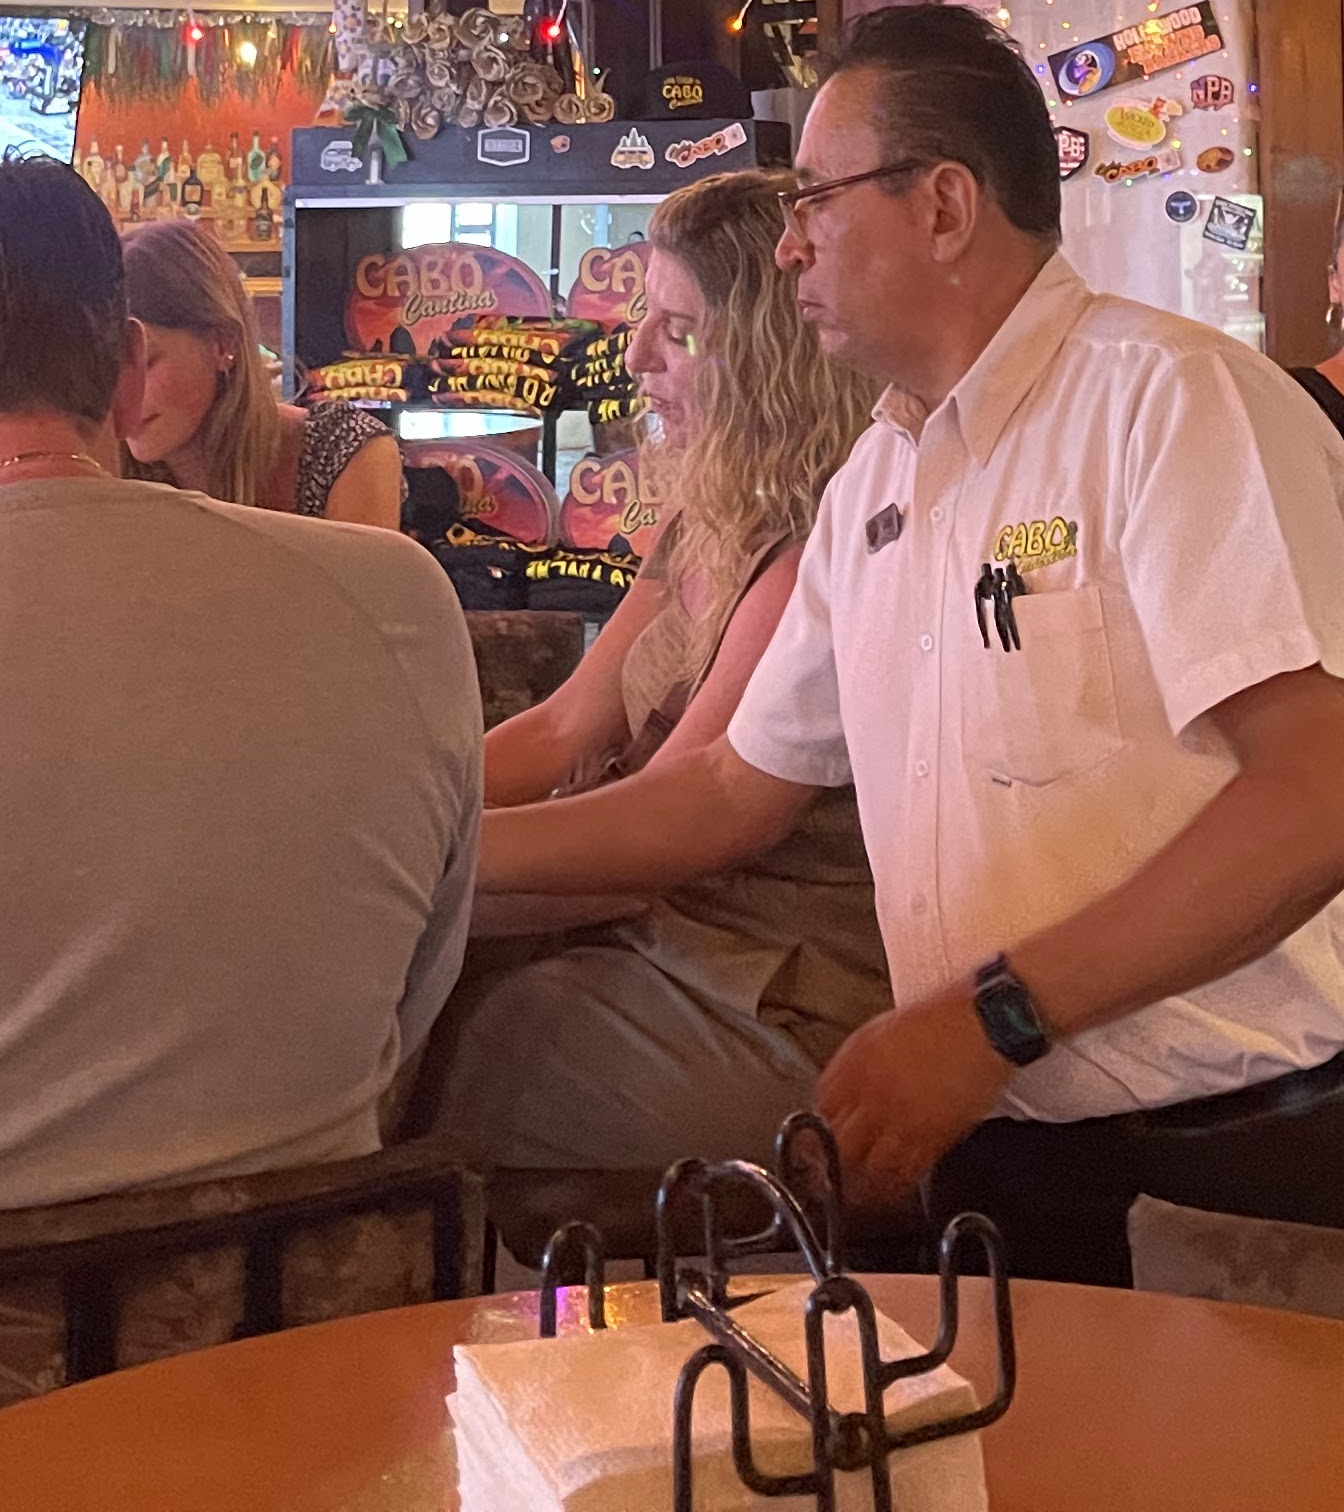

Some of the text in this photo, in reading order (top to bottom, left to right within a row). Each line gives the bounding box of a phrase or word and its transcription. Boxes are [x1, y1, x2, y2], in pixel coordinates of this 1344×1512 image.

[661, 84, 703, 100] CABO
[356, 251, 485, 299] CABO
[579, 246, 648, 293] CA
[402, 289, 498, 325] Cantina
[993, 515, 1070, 562] CABO
